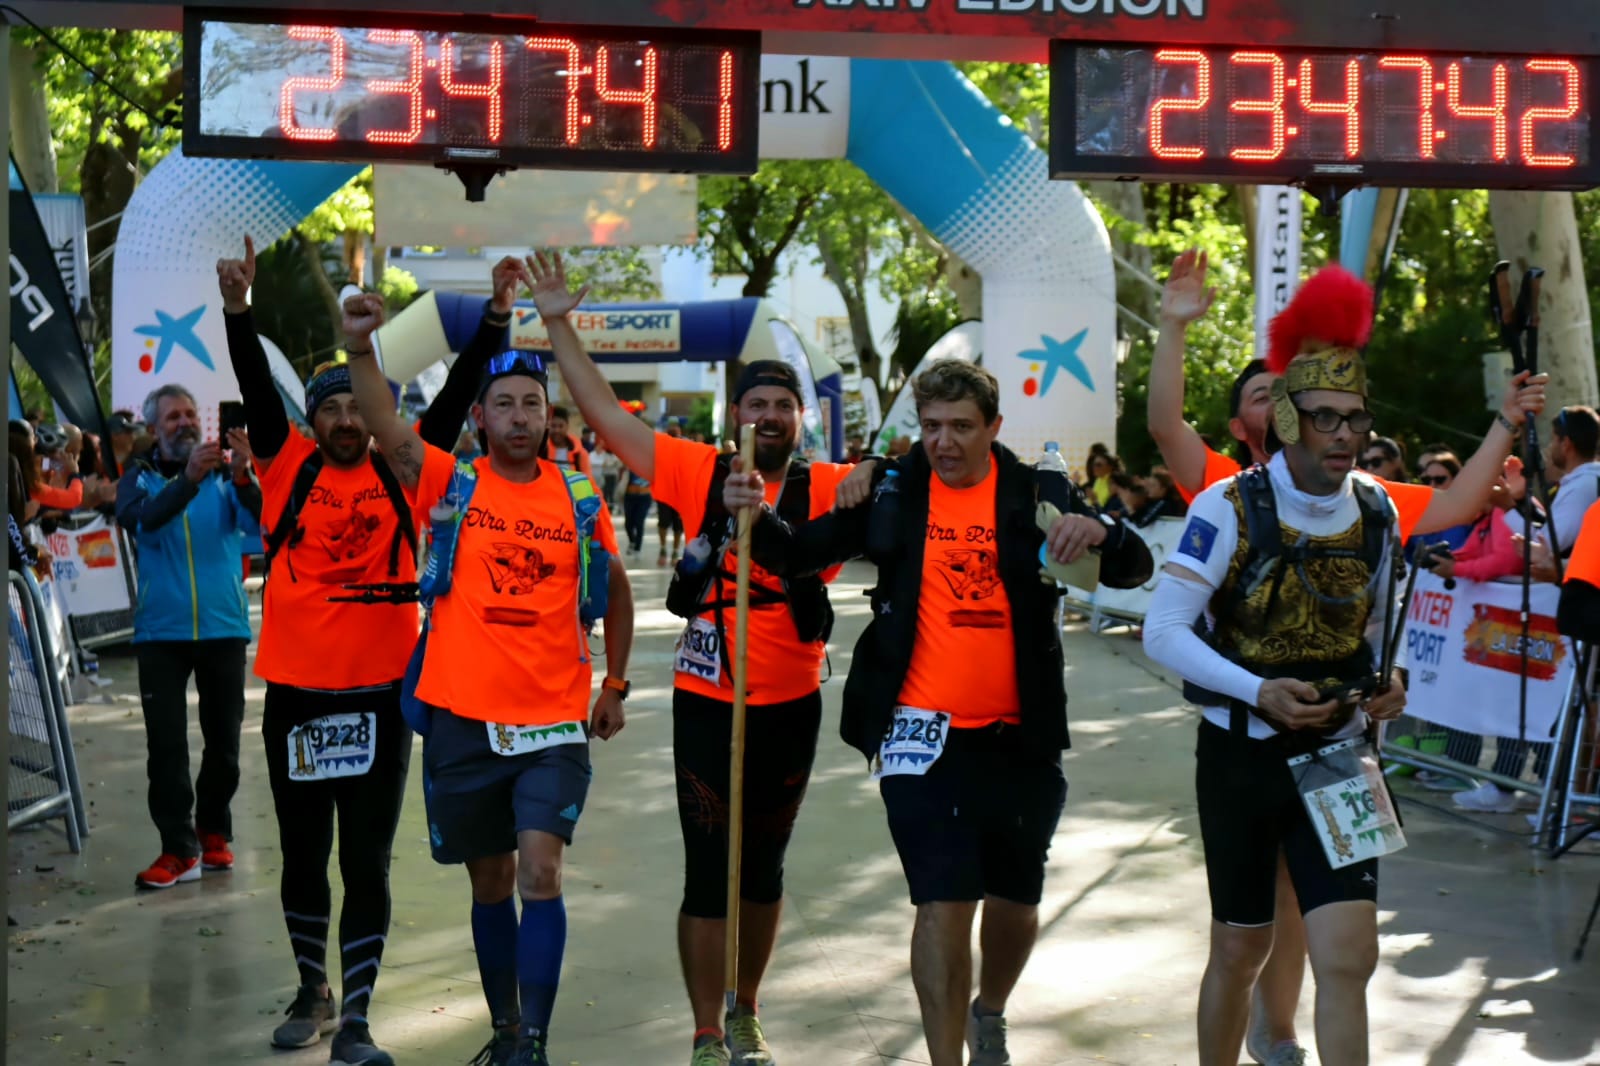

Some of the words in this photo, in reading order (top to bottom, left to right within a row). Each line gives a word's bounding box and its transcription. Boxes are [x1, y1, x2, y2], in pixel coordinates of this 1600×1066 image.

[280, 25, 732, 150] 23:47:41
[762, 57, 832, 113] nk
[1150, 49, 1578, 166] 23:47:42
[463, 507, 507, 532] Otra
[514, 519, 574, 544] Ronda
[926, 522, 958, 541] tra
[1408, 589, 1454, 629] NTER
[1407, 628, 1446, 667] PORT
[310, 723, 370, 749] 9228
